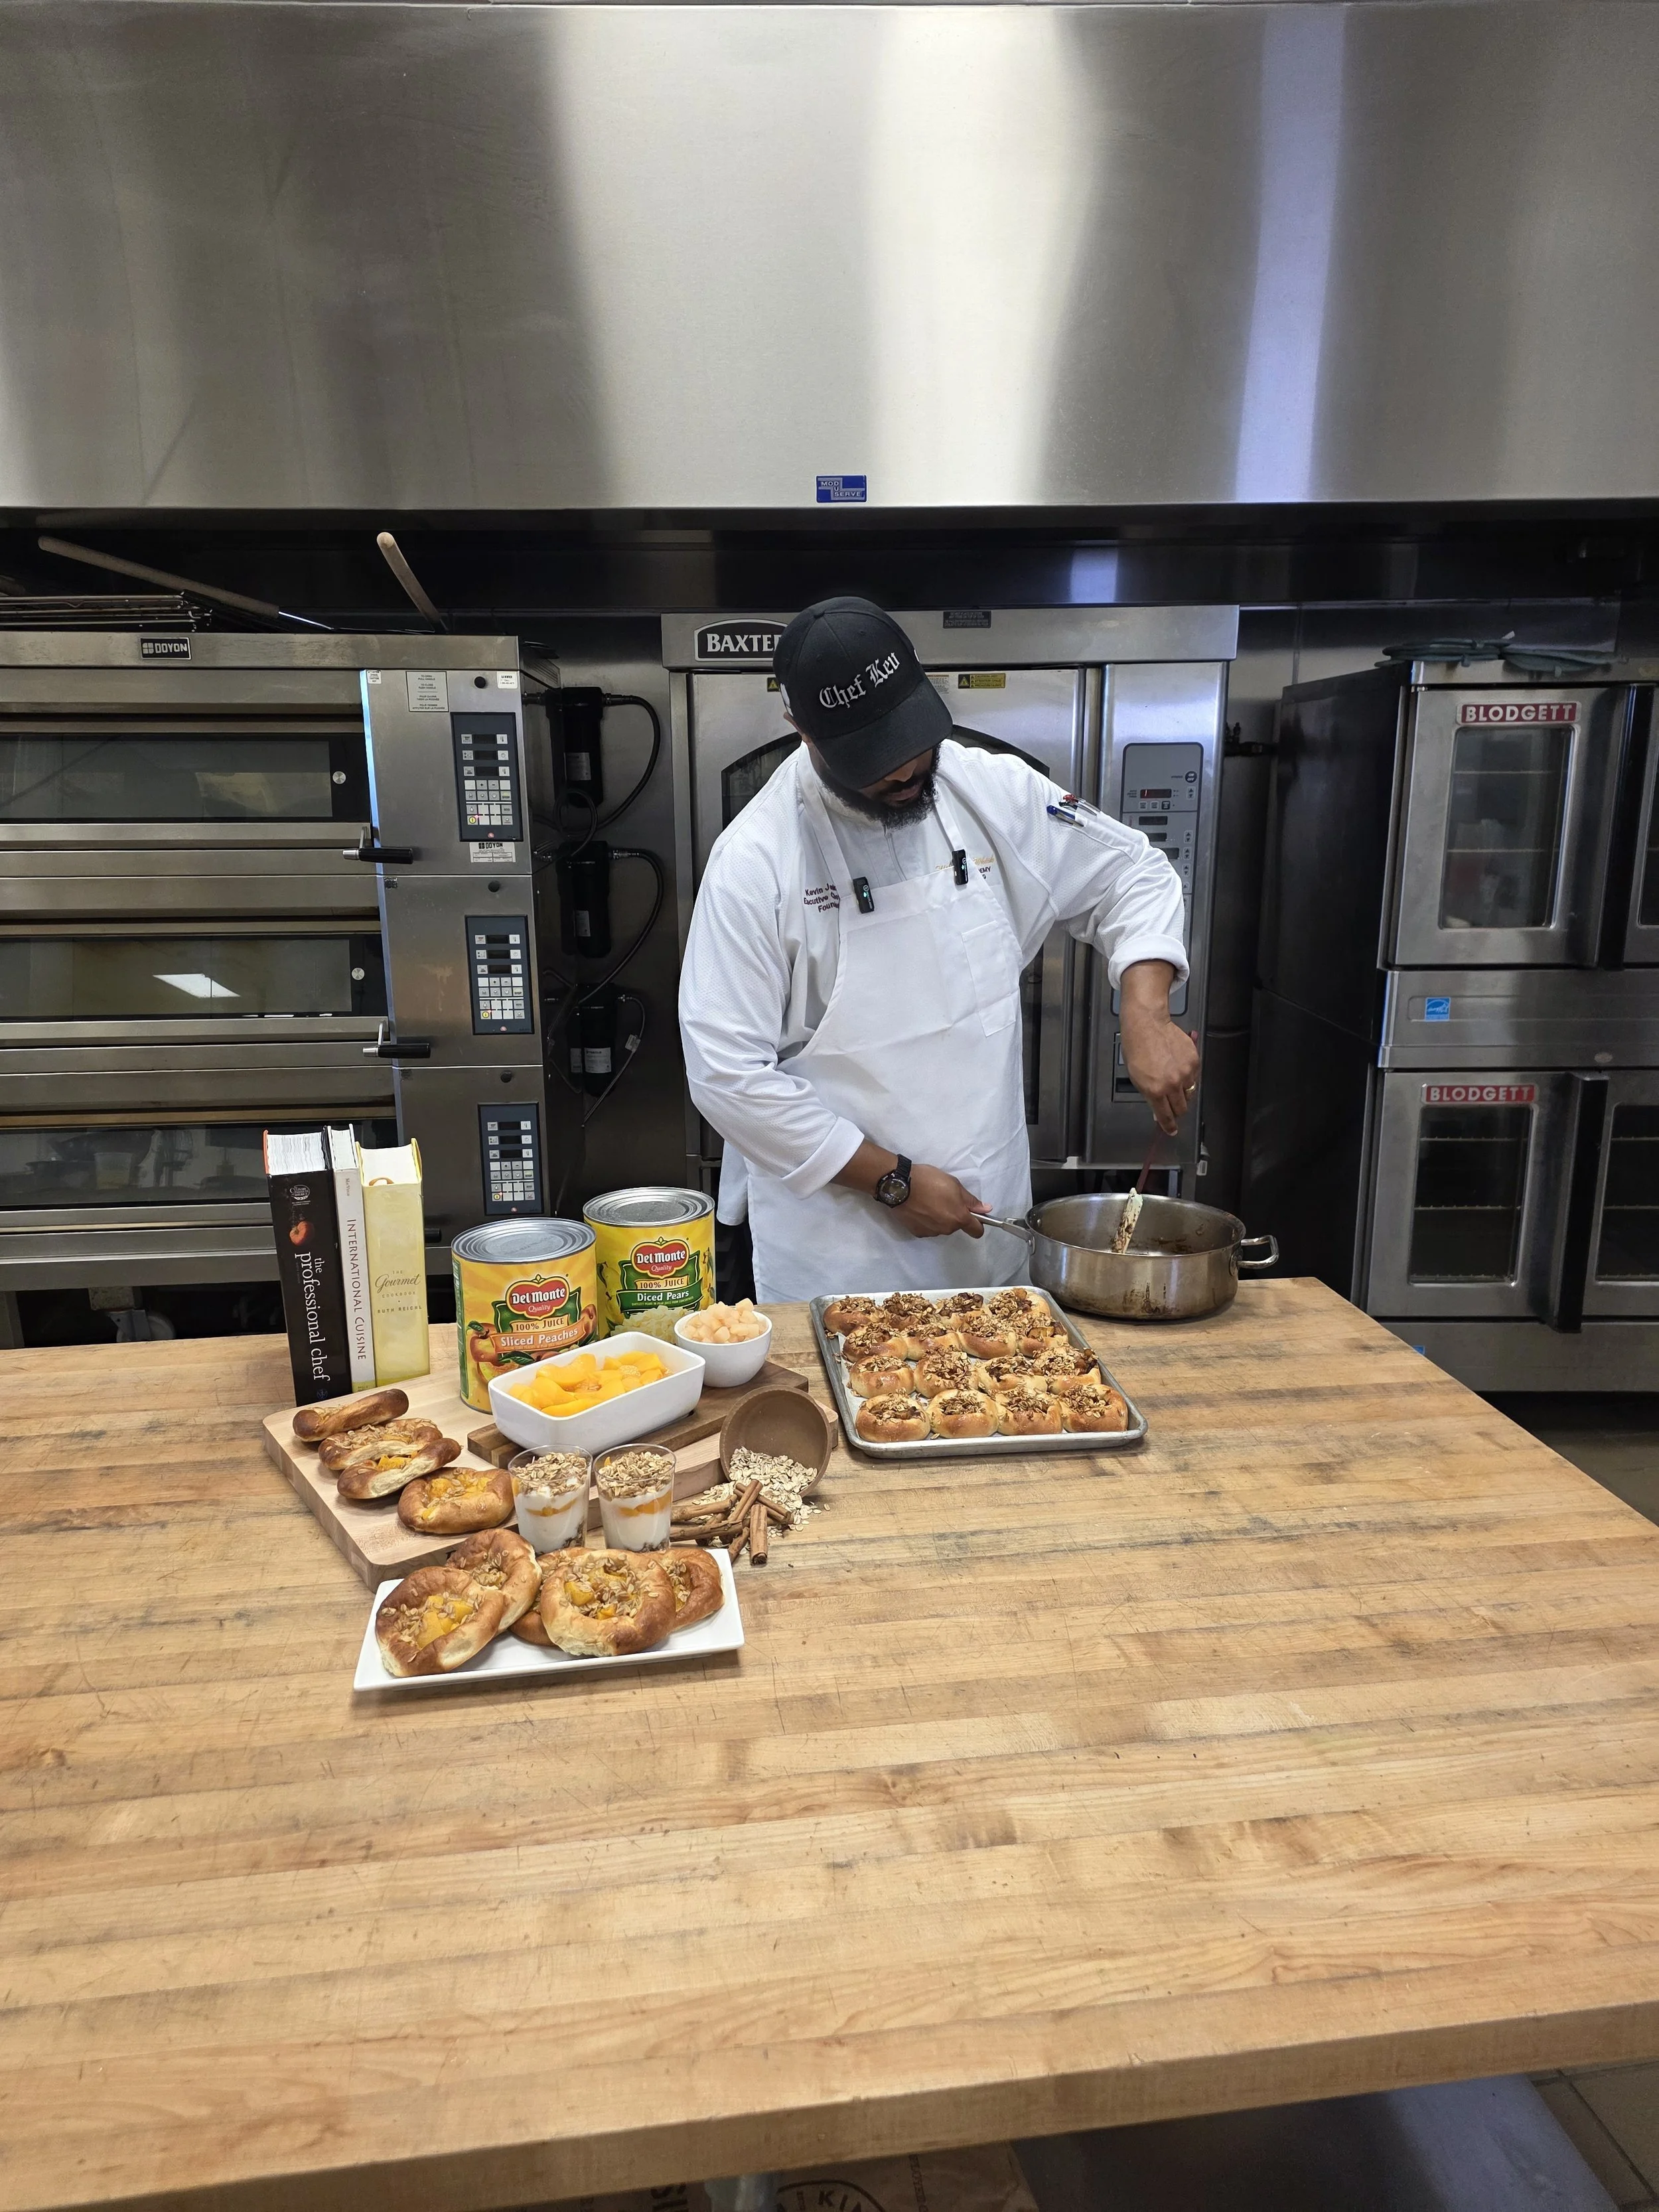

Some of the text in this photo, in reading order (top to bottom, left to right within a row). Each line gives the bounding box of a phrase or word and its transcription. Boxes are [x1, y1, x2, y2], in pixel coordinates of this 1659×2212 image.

[155, 642, 188, 654] DOYON
[819, 674, 866, 709] Chef
[865, 652, 901, 688] Kev
[1465, 704, 1573, 722] BLODGETT
[804, 887, 824, 897] Kevin
[1429, 1086, 1530, 1101] BLODGETT
[636, 1250, 685, 1264] Del Monte
[314, 1258, 325, 1274] the
[347, 1219, 366, 1361] INTERNATIONAL CUISINE
[375, 1274, 423, 1293] Gourmet
[664, 1278, 684, 1288] JUICE
[512, 1288, 565, 1304] Del Monte
[637, 1290, 689, 1301] Diced Pears
[528, 1304, 551, 1313] Quality
[294, 1252, 331, 1381] professional chef
[516, 1317, 565, 1331] 100% JUICE
[500, 1335, 534, 1347] Sliced
[538, 1328, 579, 1345] Peaches
